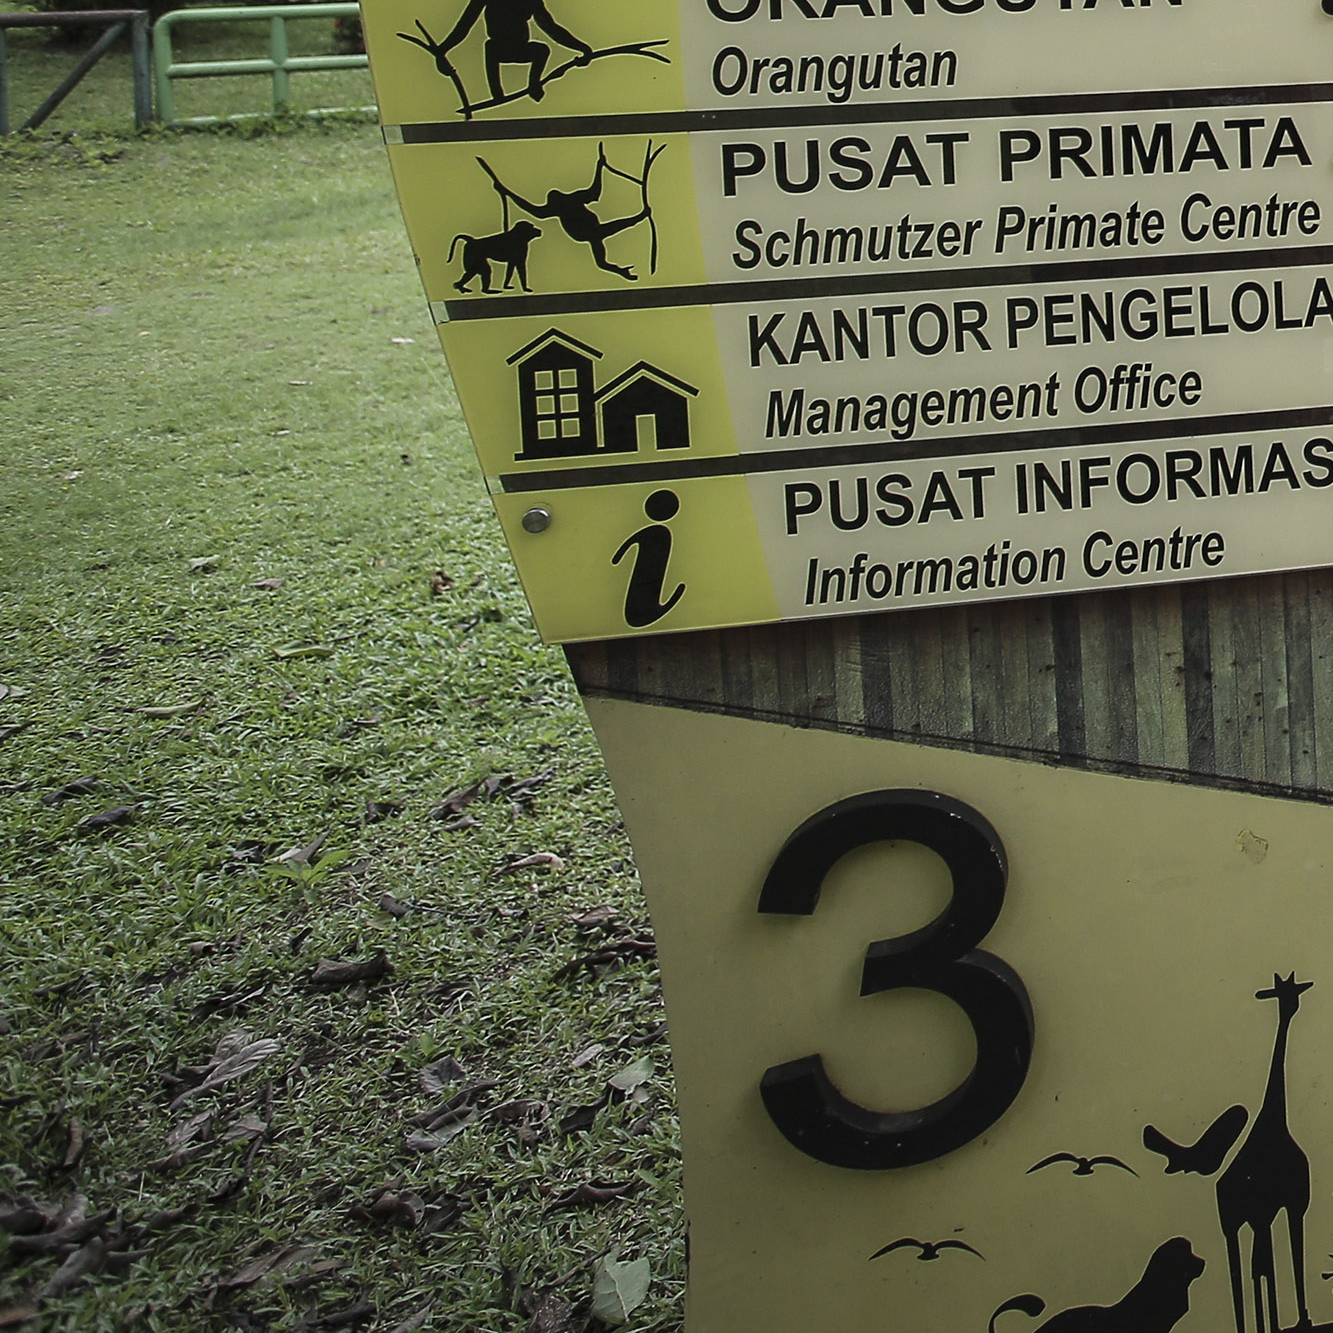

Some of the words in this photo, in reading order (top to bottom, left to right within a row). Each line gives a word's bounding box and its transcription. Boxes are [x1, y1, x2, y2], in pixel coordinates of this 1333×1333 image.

[712, 42, 957, 104] Orangutan
[721, 132, 970, 197] PUSAT
[999, 117, 1313, 182] PRIMATA
[732, 213, 983, 269] Schmutzer
[994, 201, 1165, 254] Primate
[1180, 192, 1321, 242] Centre
[748, 300, 992, 368] KANTOR
[765, 371, 1061, 441] Management
[1074, 363, 1202, 414] Office
[784, 466, 996, 535] PUSAT
[805, 540, 1066, 606] Information
[1083, 526, 1225, 578] Centre
[757, 789, 1036, 1171] 3
